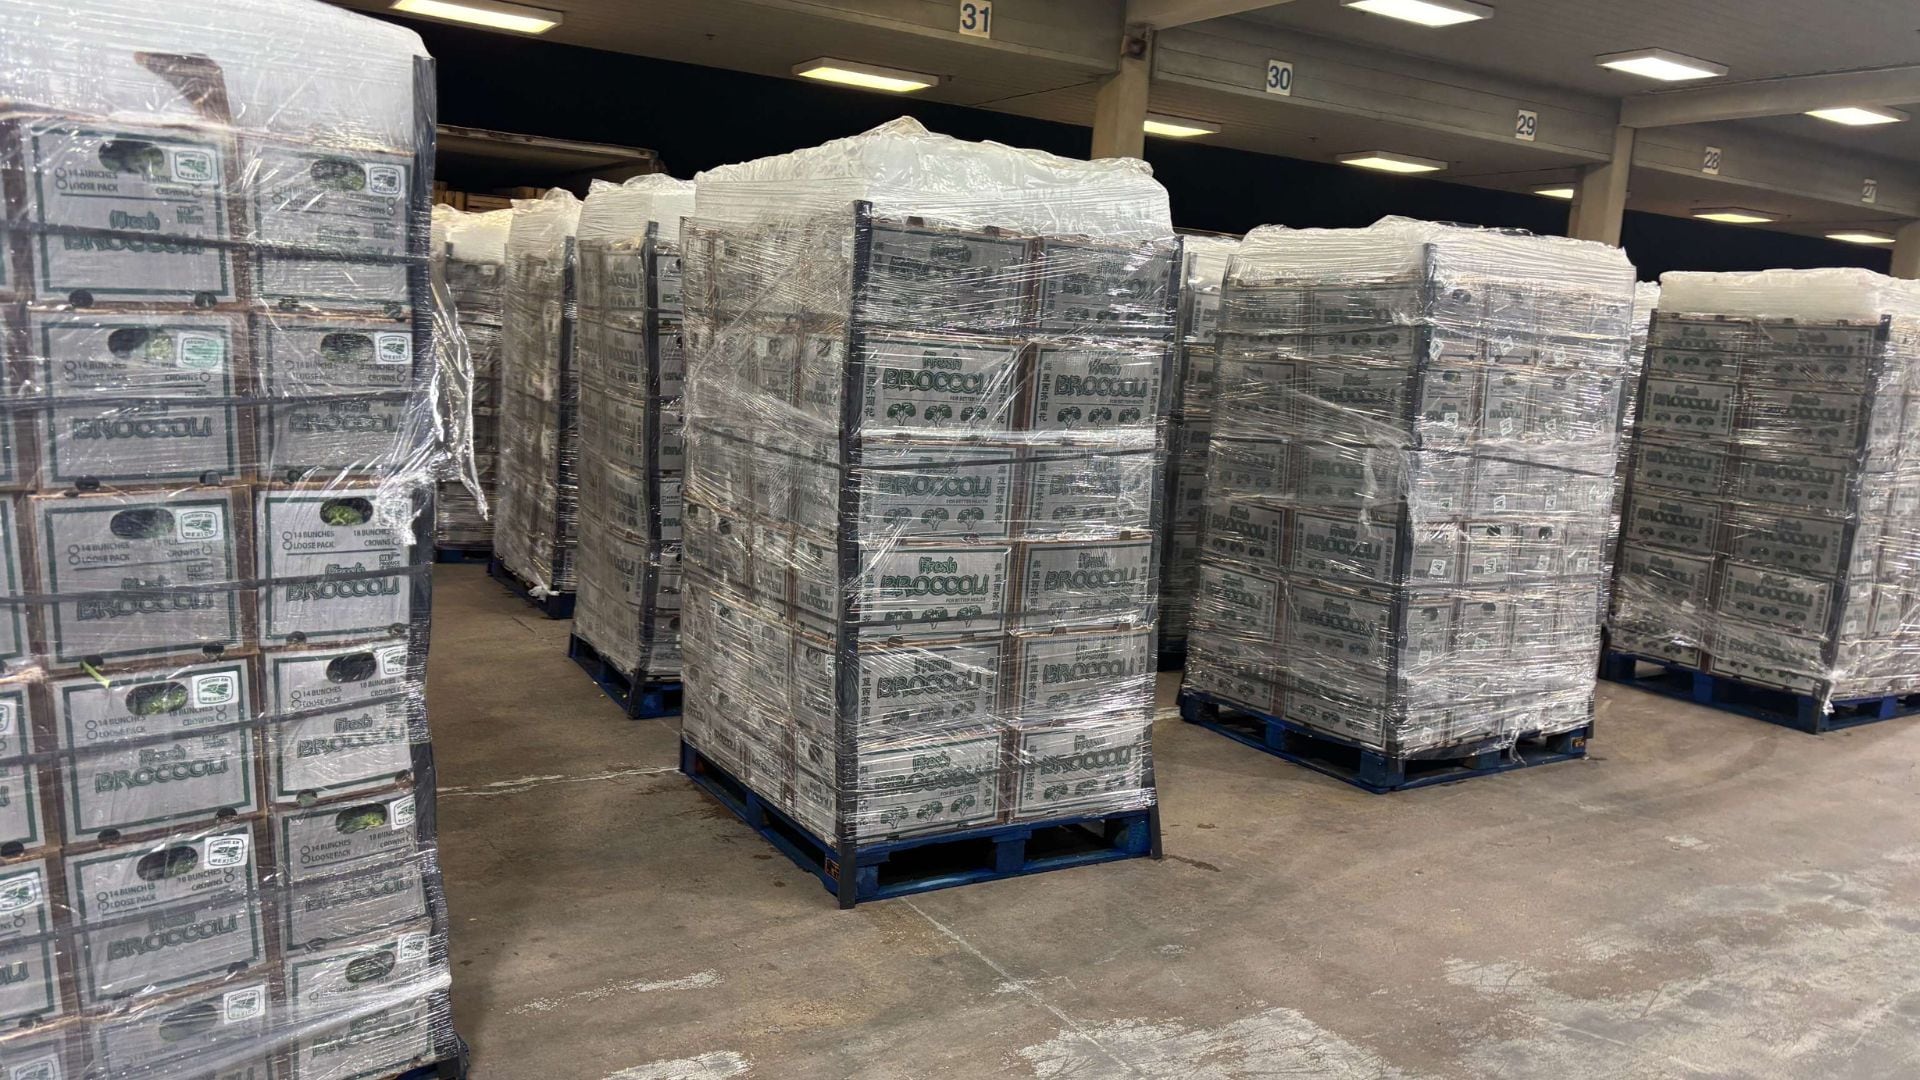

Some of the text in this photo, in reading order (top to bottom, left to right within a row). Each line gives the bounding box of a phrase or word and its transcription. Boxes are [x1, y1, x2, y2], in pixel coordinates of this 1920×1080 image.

[962, 3, 989, 33] 31
[1269, 65, 1291, 90] 30
[1517, 114, 1535, 136] 29
[1705, 151, 1720, 170] 28
[922, 350, 963, 371] Fresh
[883, 367, 994, 395] BROCCOLI
[1054, 374, 1148, 398] BROCCOLI
[1652, 392, 1720, 412] BROCCOLI
[73, 416, 213, 441] BROCCOLI
[1646, 449, 1712, 471] BROCCOLI
[1754, 463, 1835, 485] BROCCOLI
[880, 475, 992, 497] BROCCOLI
[1212, 513, 1269, 542] BROCCOLI
[1637, 507, 1704, 530] BROCCOLI
[185, 529, 214, 538] MEXICO
[303, 530, 335, 538] BUNCHES
[361, 528, 391, 537] BUNCHES
[364, 539, 391, 547] CROWNS
[92, 543, 130, 552] BUNCHES
[293, 541, 335, 550] LOOSE PACK
[1306, 533, 1382, 561] BROCCOLI
[918, 556, 958, 575] Fresh
[286, 576, 400, 602] BROCCOLI
[879, 573, 990, 598] BROCCOLI
[1044, 566, 1138, 592] BROCCOLI
[1734, 580, 1814, 607] BROCCOLI
[1300, 606, 1376, 637] BROCCOLI
[1042, 656, 1135, 685] BROCCOLI
[311, 686, 342, 697] BUNCHES
[877, 669, 982, 699] BROCCOLI
[202, 693, 229, 702] MEXICO
[108, 715, 146, 725] BUNCHES
[178, 706, 214, 716] BUNCHES
[333, 713, 373, 733] Fresh
[912, 750, 951, 772] Fresh
[95, 754, 229, 794] BROCCOLI
[320, 838, 352, 850] BUNCHES
[212, 855, 239, 864] MEXICO
[311, 853, 334, 862] LOOSE
[187, 869, 222, 882] BUNCHES
[119, 882, 156, 896] BUNCHES
[110, 894, 157, 909] LOOSE PACK
[107, 913, 238, 962] BROCCOLI
